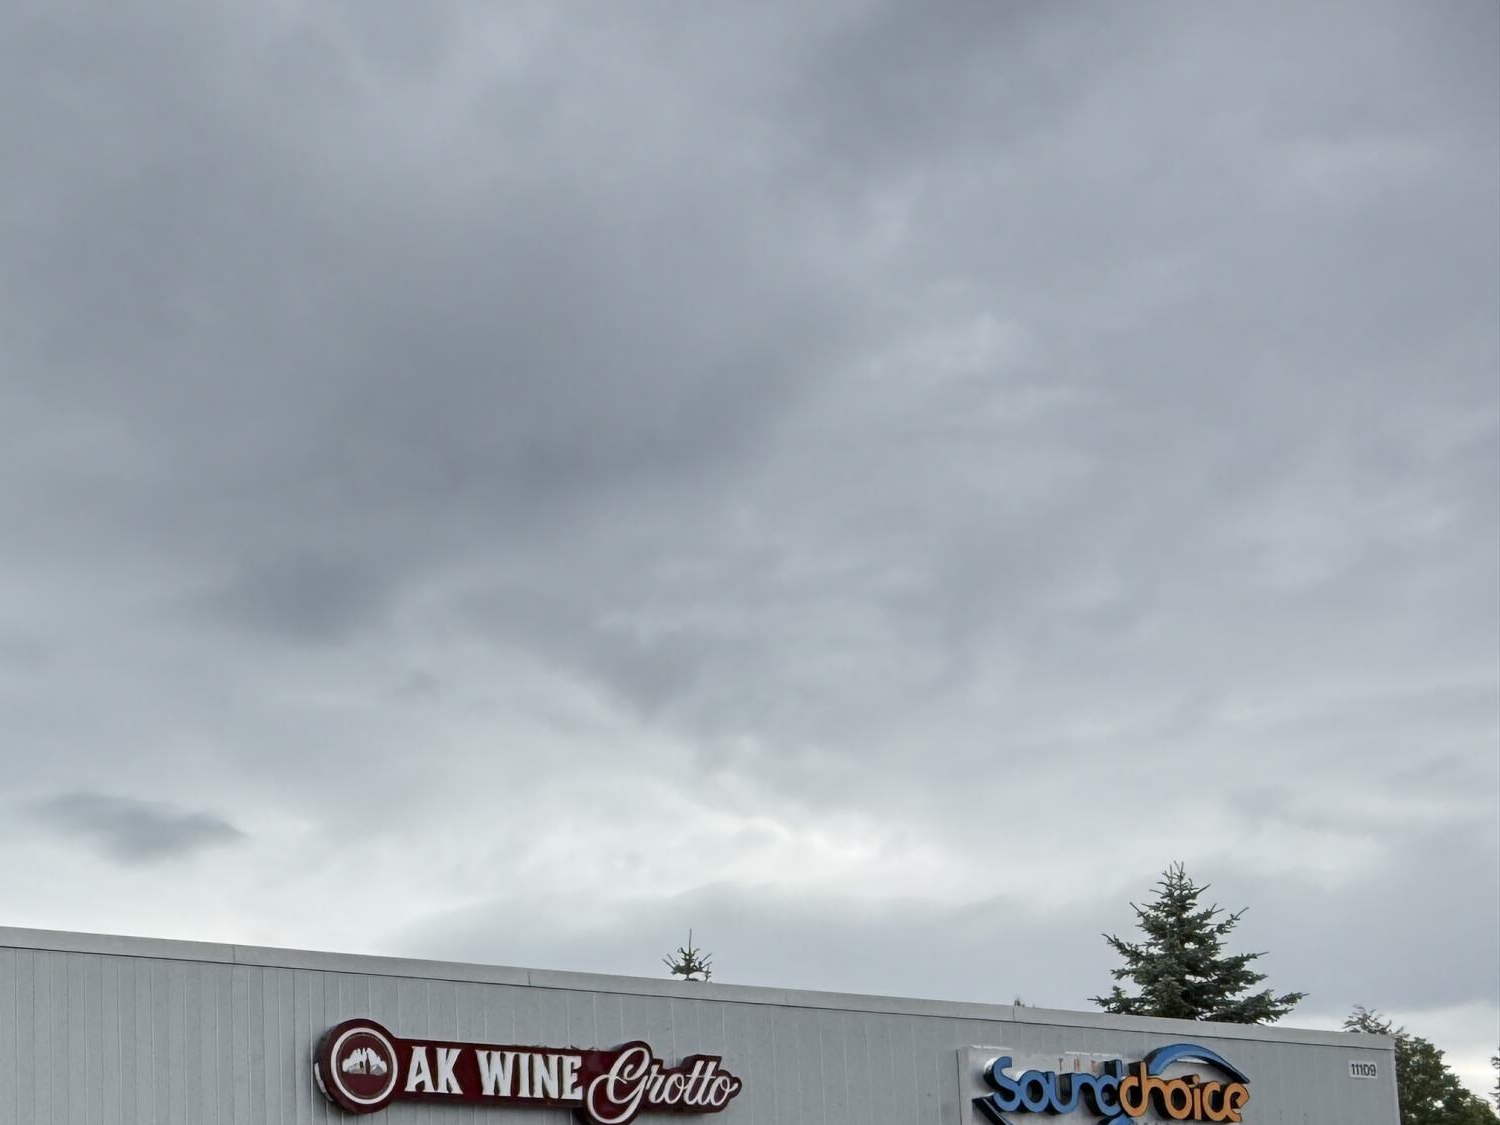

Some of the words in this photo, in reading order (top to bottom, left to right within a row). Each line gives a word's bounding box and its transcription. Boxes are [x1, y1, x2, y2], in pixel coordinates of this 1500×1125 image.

[404, 1045, 464, 1096] AK
[476, 1049, 584, 1101] WINE
[587, 1046, 740, 1125] Grotto
[1351, 1063, 1377, 1077] 11109
